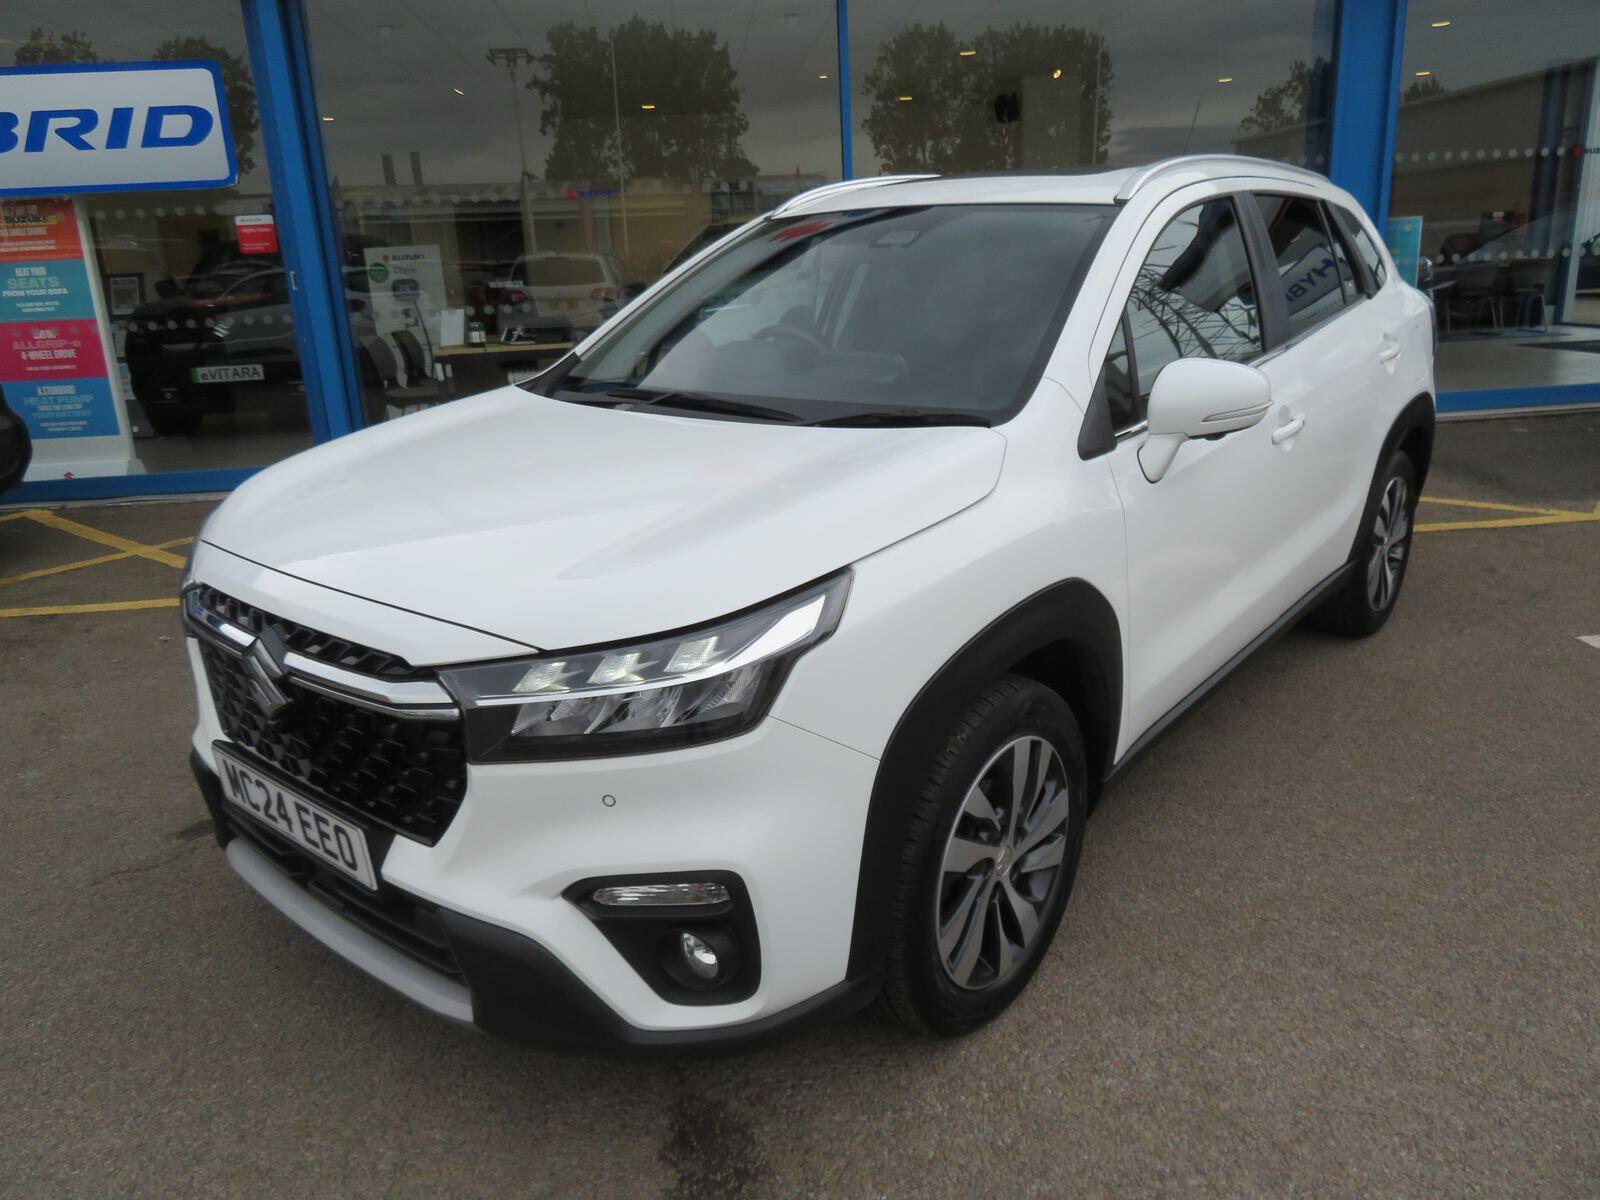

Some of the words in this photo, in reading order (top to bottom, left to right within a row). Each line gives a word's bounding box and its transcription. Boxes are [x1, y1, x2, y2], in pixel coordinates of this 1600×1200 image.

[0, 105, 214, 153] RID
[8, 276, 60, 288] SEATS
[2, 290, 25, 298] FROM
[25, 289, 47, 297] YOUR
[47, 287, 70, 296] SOFA
[21, 350, 54, 360] 4-WHEEL
[54, 348, 77, 359] DRIVE
[201, 367, 262, 381] eVITARA
